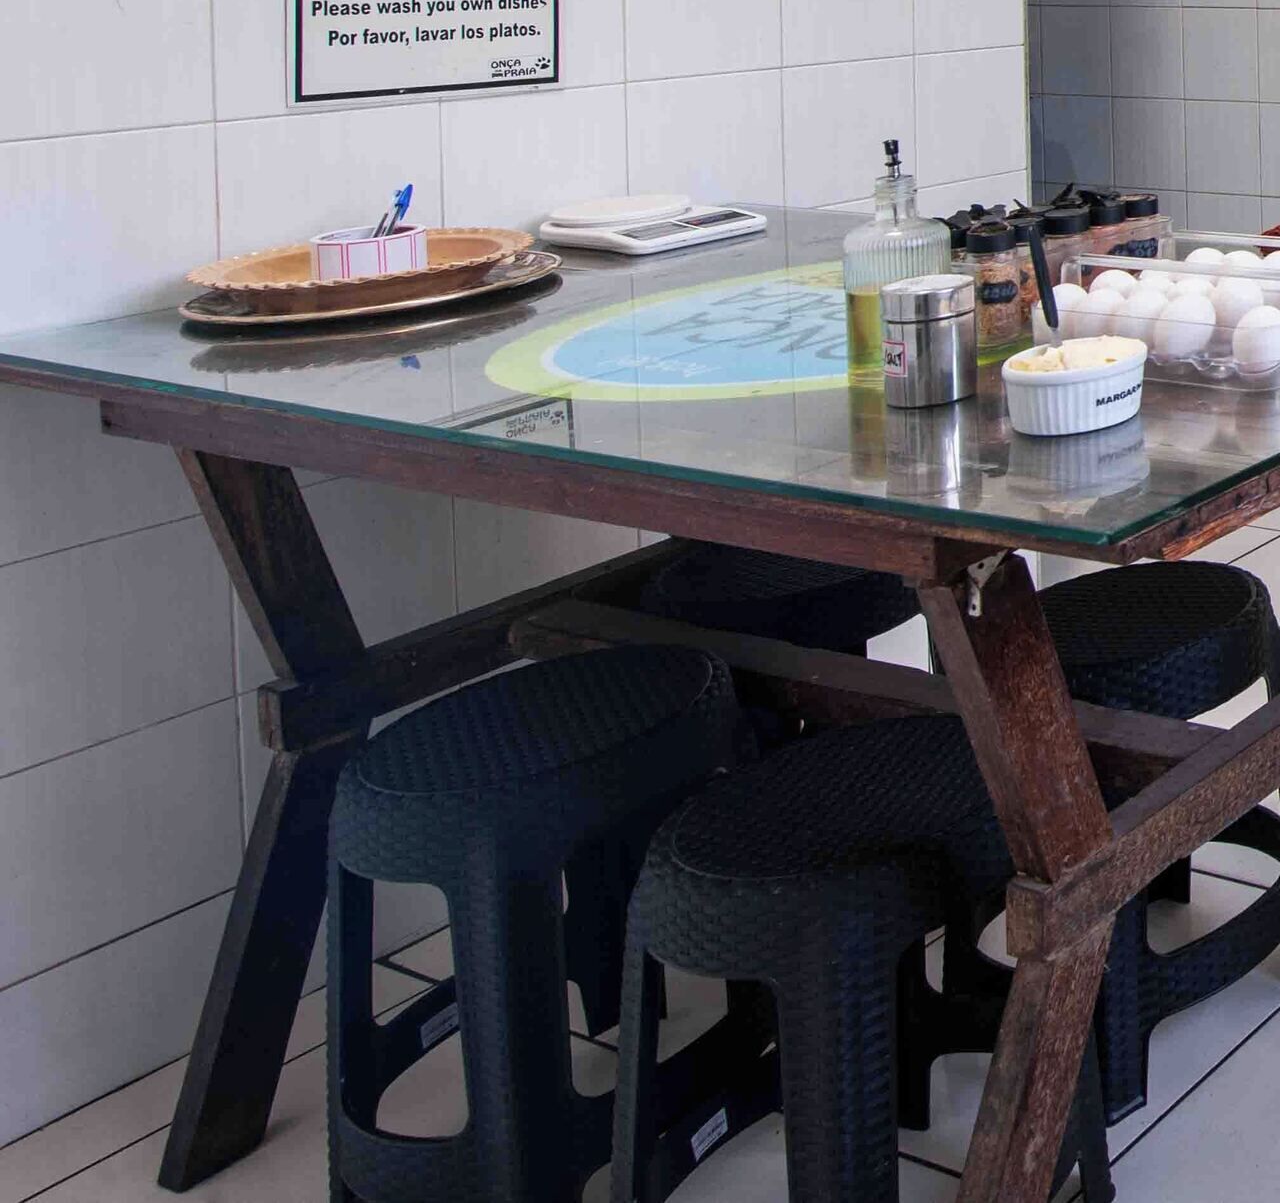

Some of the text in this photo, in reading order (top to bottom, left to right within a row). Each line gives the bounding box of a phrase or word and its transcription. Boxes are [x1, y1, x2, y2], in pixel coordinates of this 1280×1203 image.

[311, 0, 371, 17] Please
[427, 0, 456, 17] you
[328, 22, 541, 46] Por favor, lavar los platos.
[491, 59, 521, 69] ONÇA
[504, 67, 537, 77] PRAIA
